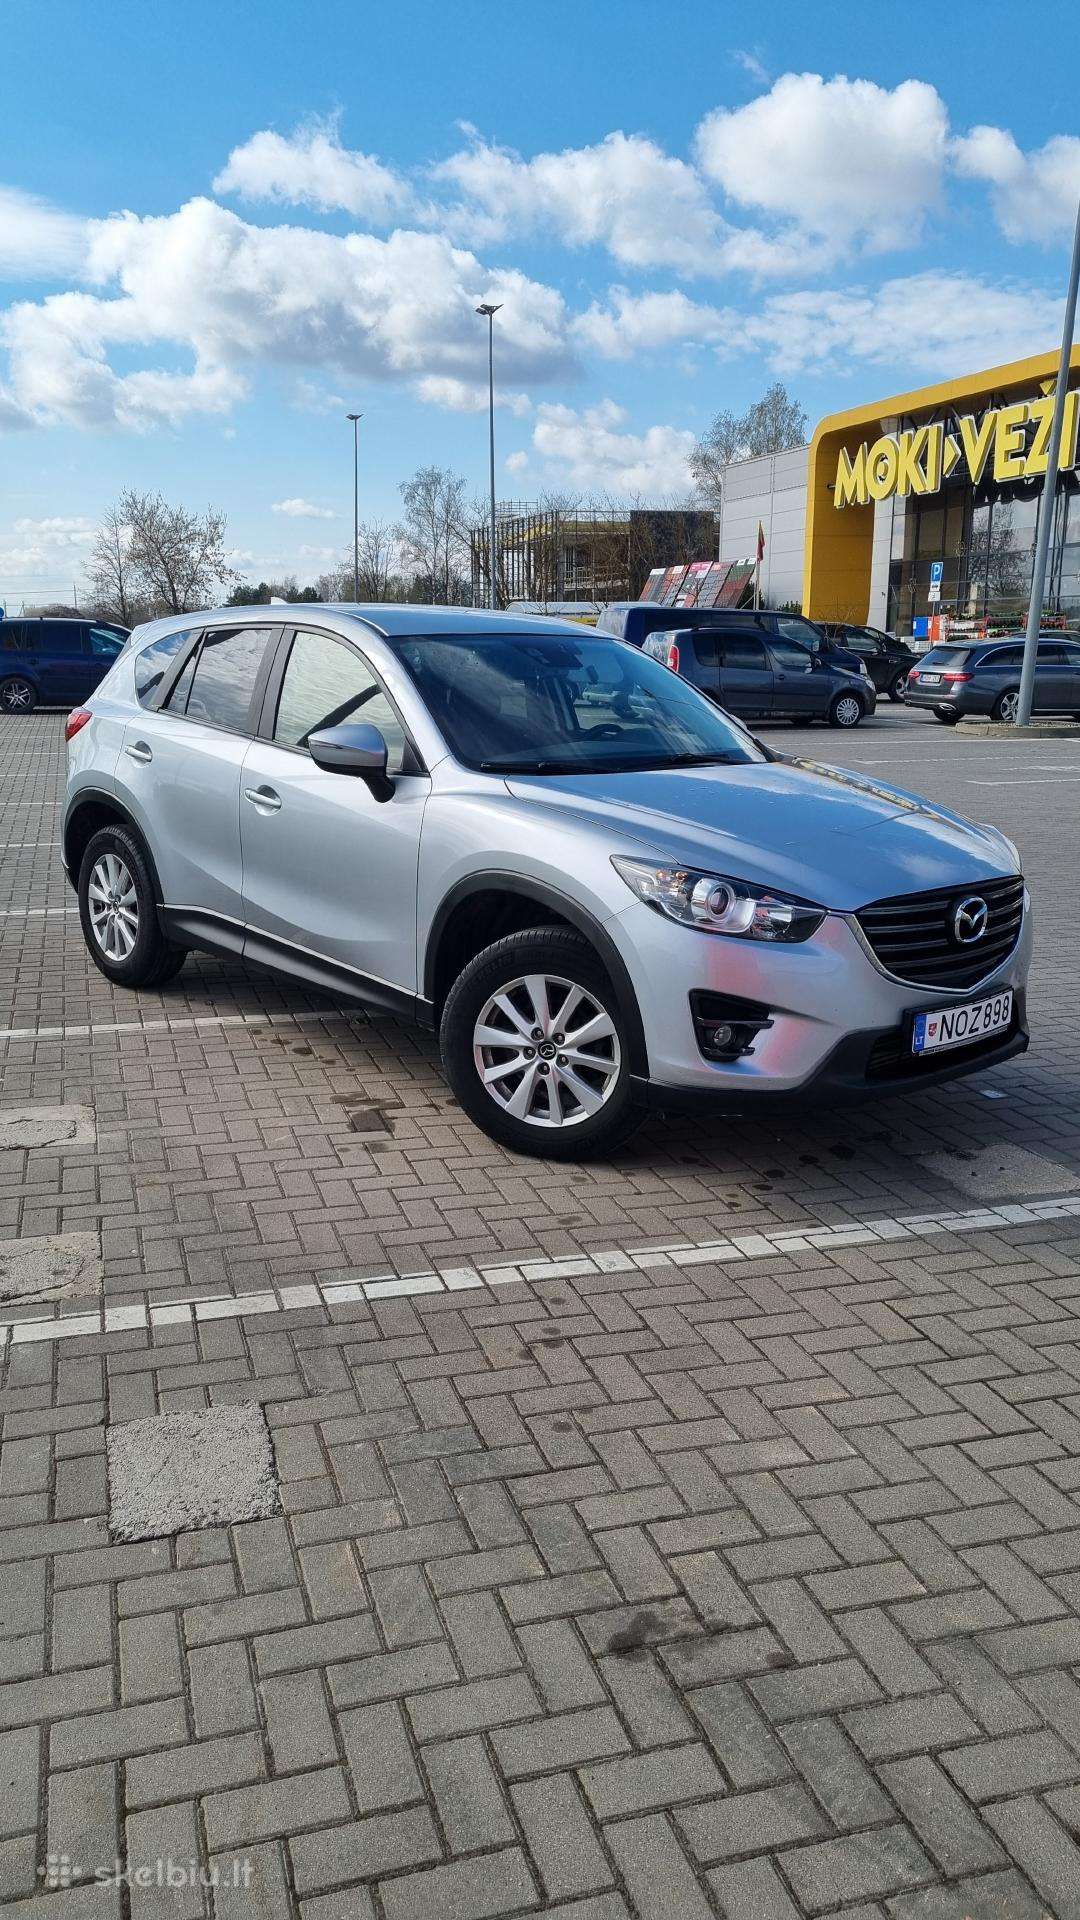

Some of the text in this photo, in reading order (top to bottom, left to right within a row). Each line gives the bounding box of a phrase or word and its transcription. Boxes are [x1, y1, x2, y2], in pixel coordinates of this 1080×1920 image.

[833, 379, 1080, 508] MOKI VEŽI
[933, 564, 941, 580] P
[939, 995, 1010, 1042] NOZ898
[915, 1036, 924, 1045] LT
